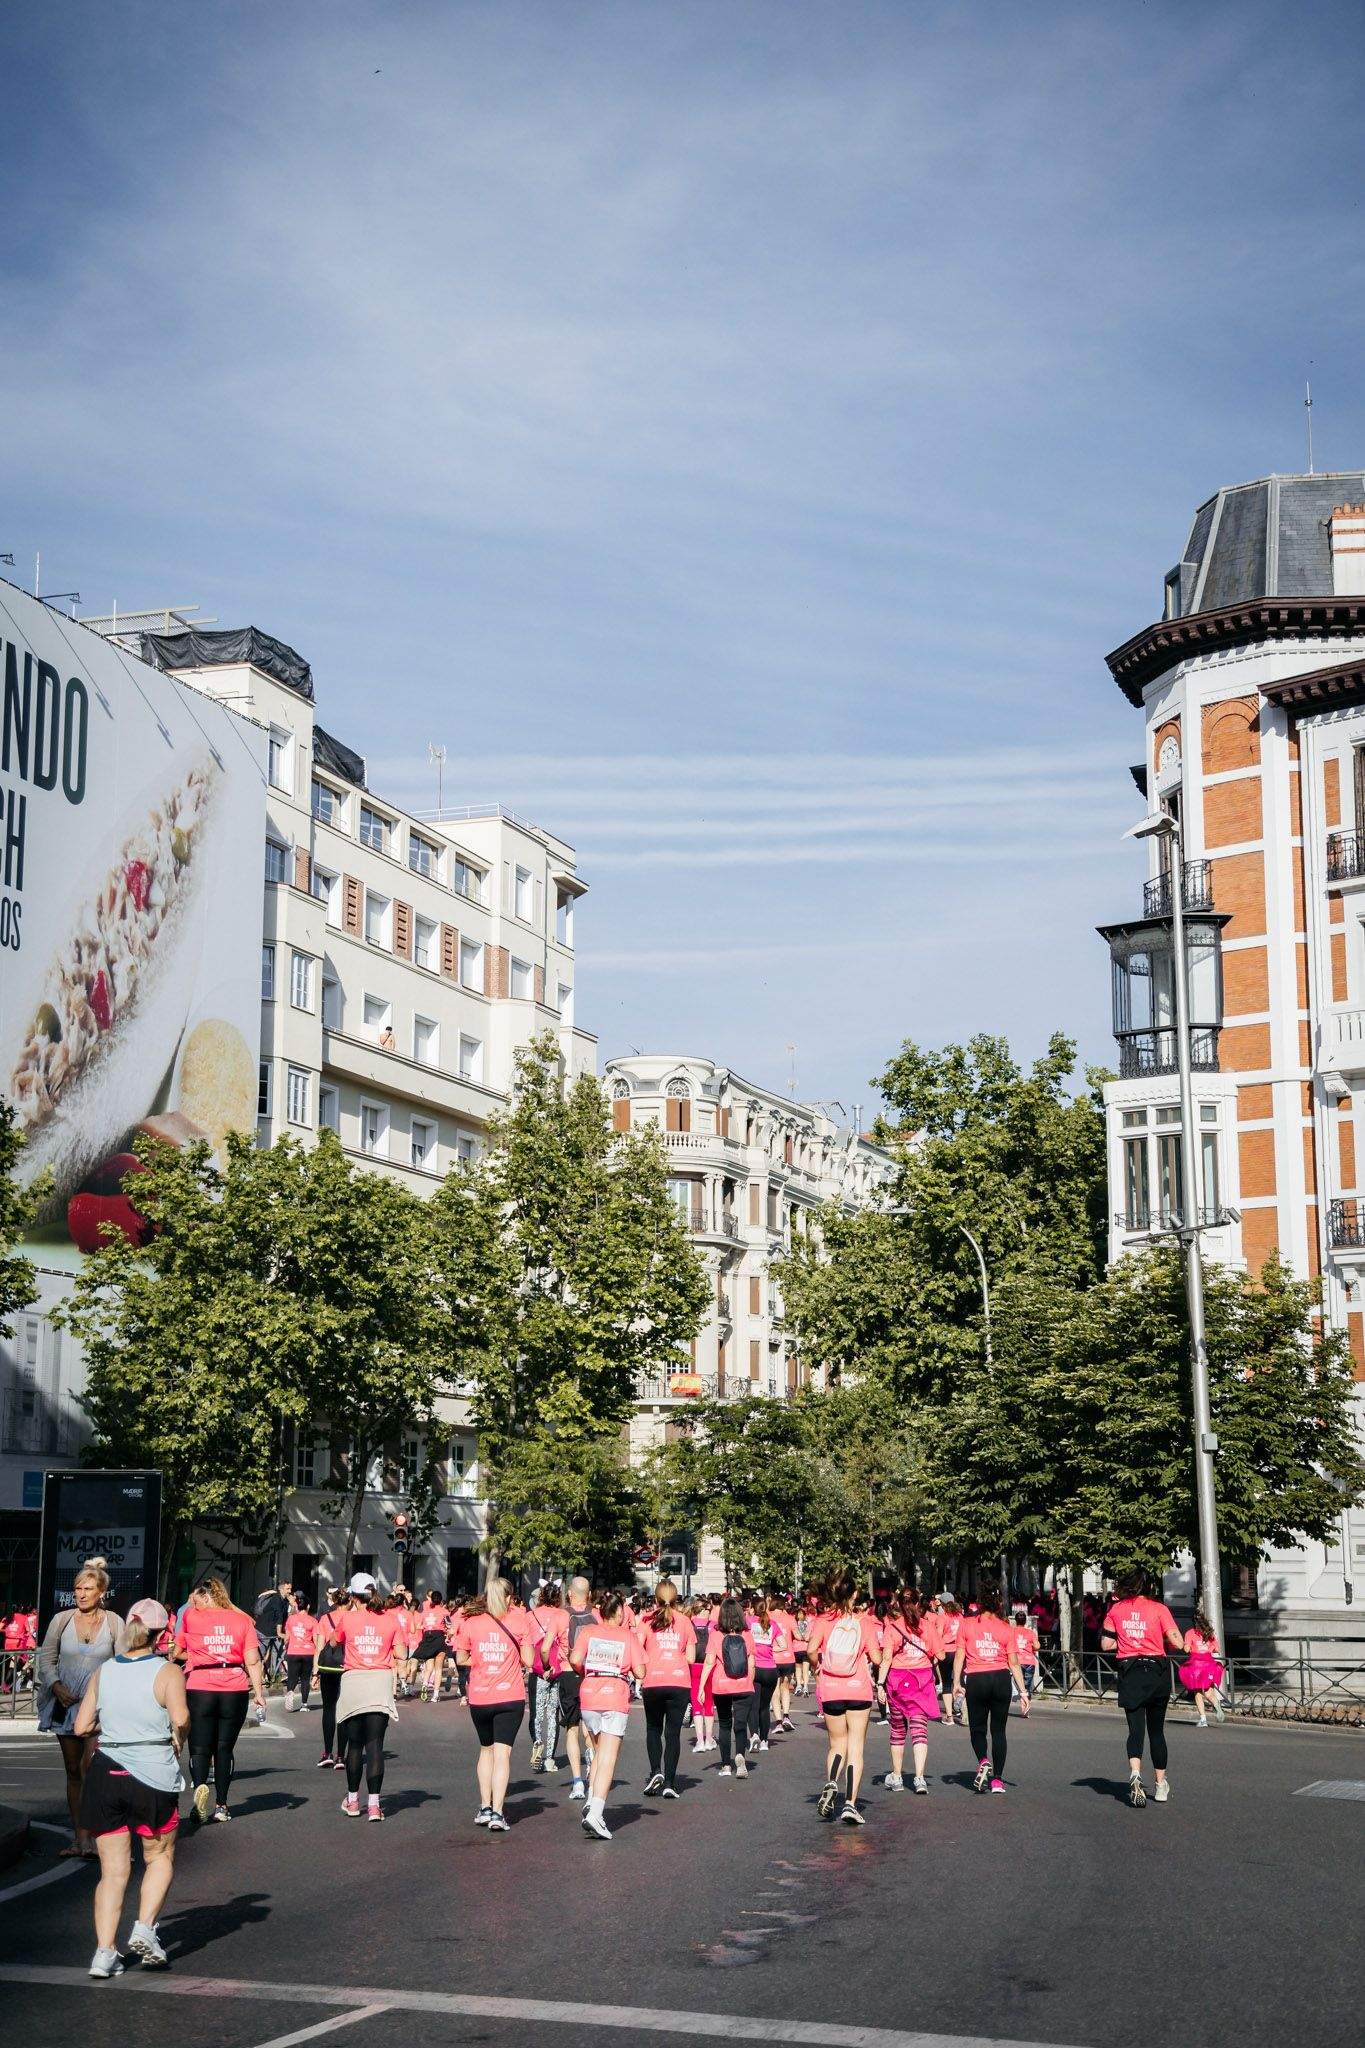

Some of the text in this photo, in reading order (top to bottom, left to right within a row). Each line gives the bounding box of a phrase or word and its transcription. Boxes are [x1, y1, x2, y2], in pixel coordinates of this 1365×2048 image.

[0, 637, 88, 805] NDO
[0, 785, 27, 892] H
[57, 1535, 125, 1552] MADRID
[1130, 1612, 1140, 1621] TU
[214, 1625, 225, 1635] TU
[1122, 1620, 1147, 1630] DORSAL
[364, 1625, 376, 1636] TU
[1126, 1630, 1145, 1639] SUMA
[203, 1635, 235, 1645] DORSAL
[354, 1635, 384, 1646] DORSAL
[488, 1632, 500, 1642] TU
[208, 1645, 232, 1654] SUMA
[358, 1645, 380, 1655] SUMA
